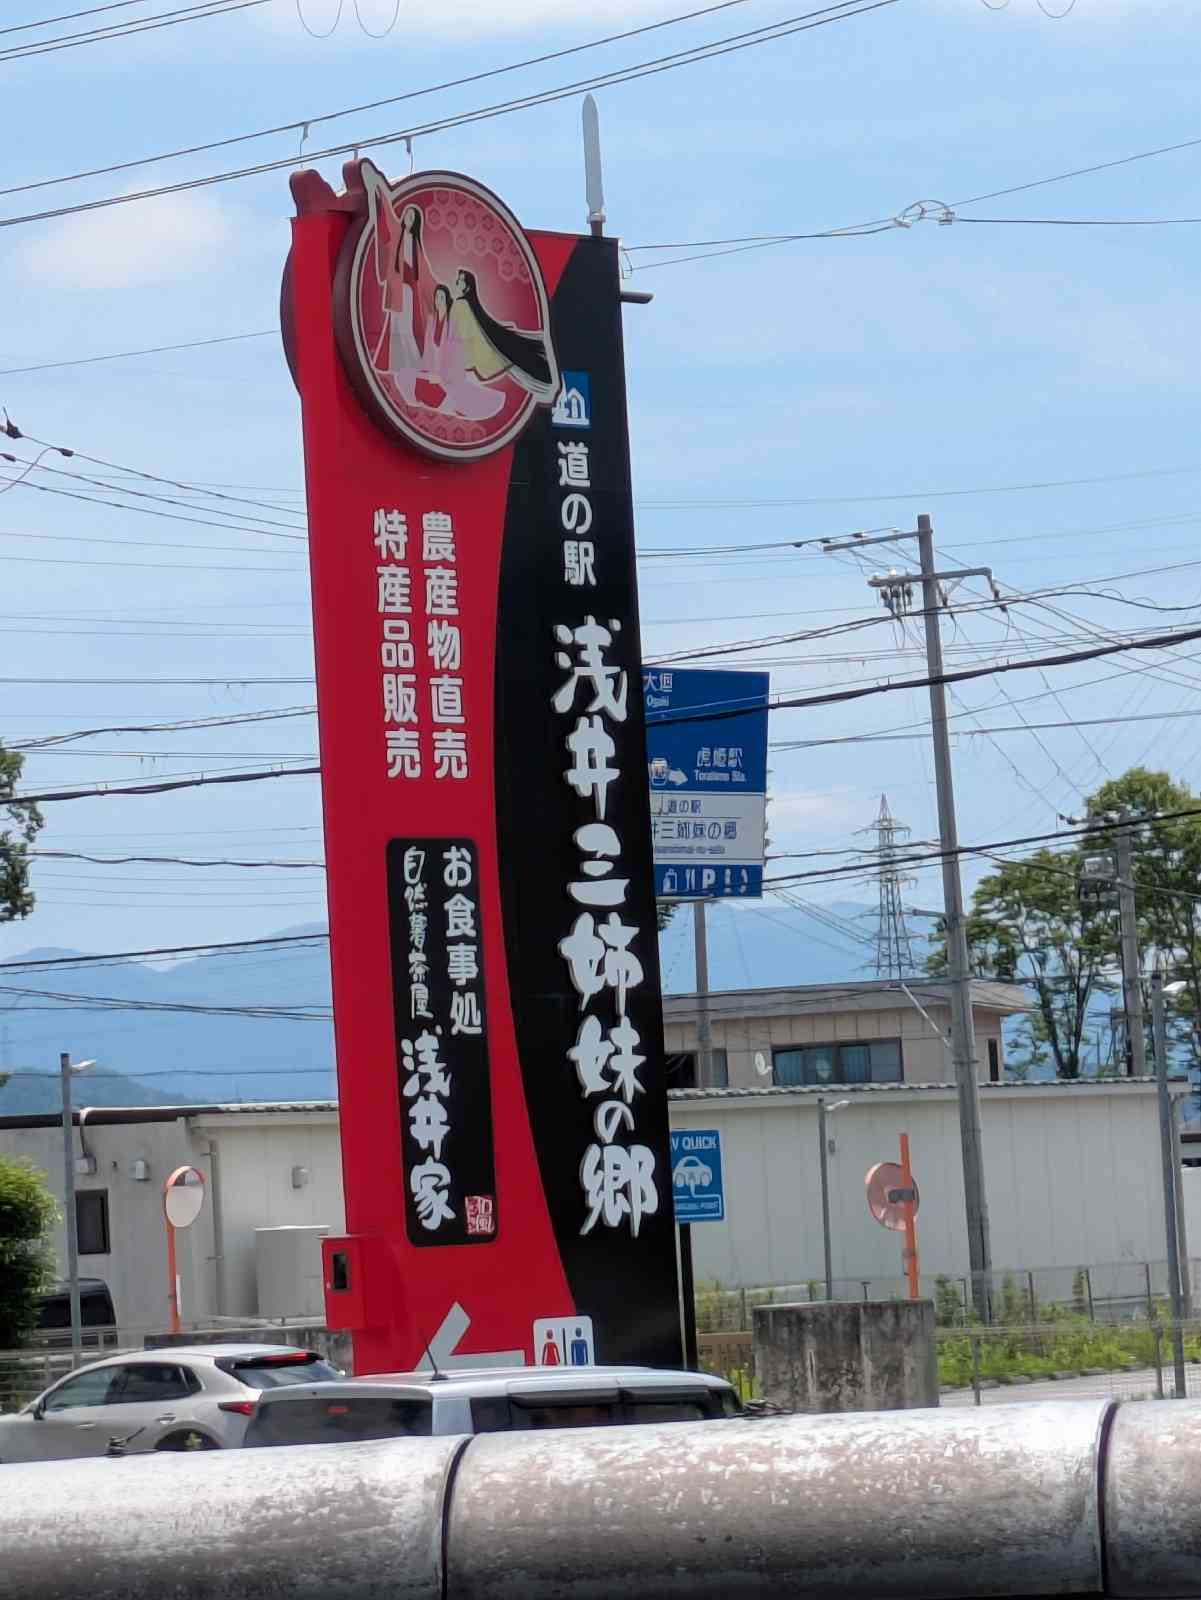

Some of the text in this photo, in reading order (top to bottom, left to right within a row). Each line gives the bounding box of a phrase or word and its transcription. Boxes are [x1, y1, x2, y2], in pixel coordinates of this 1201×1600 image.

[557, 440, 597, 586] 道の駅
[374, 508, 421, 779] 特産品販売
[421, 511, 468, 779] 農産物直売
[442, 845, 483, 1035] お食事処
[551, 614, 658, 1239] 浅井三姉妹の郷
[401, 1023, 457, 1230] 浅井家
[682, 1135, 718, 1151] QUICK
